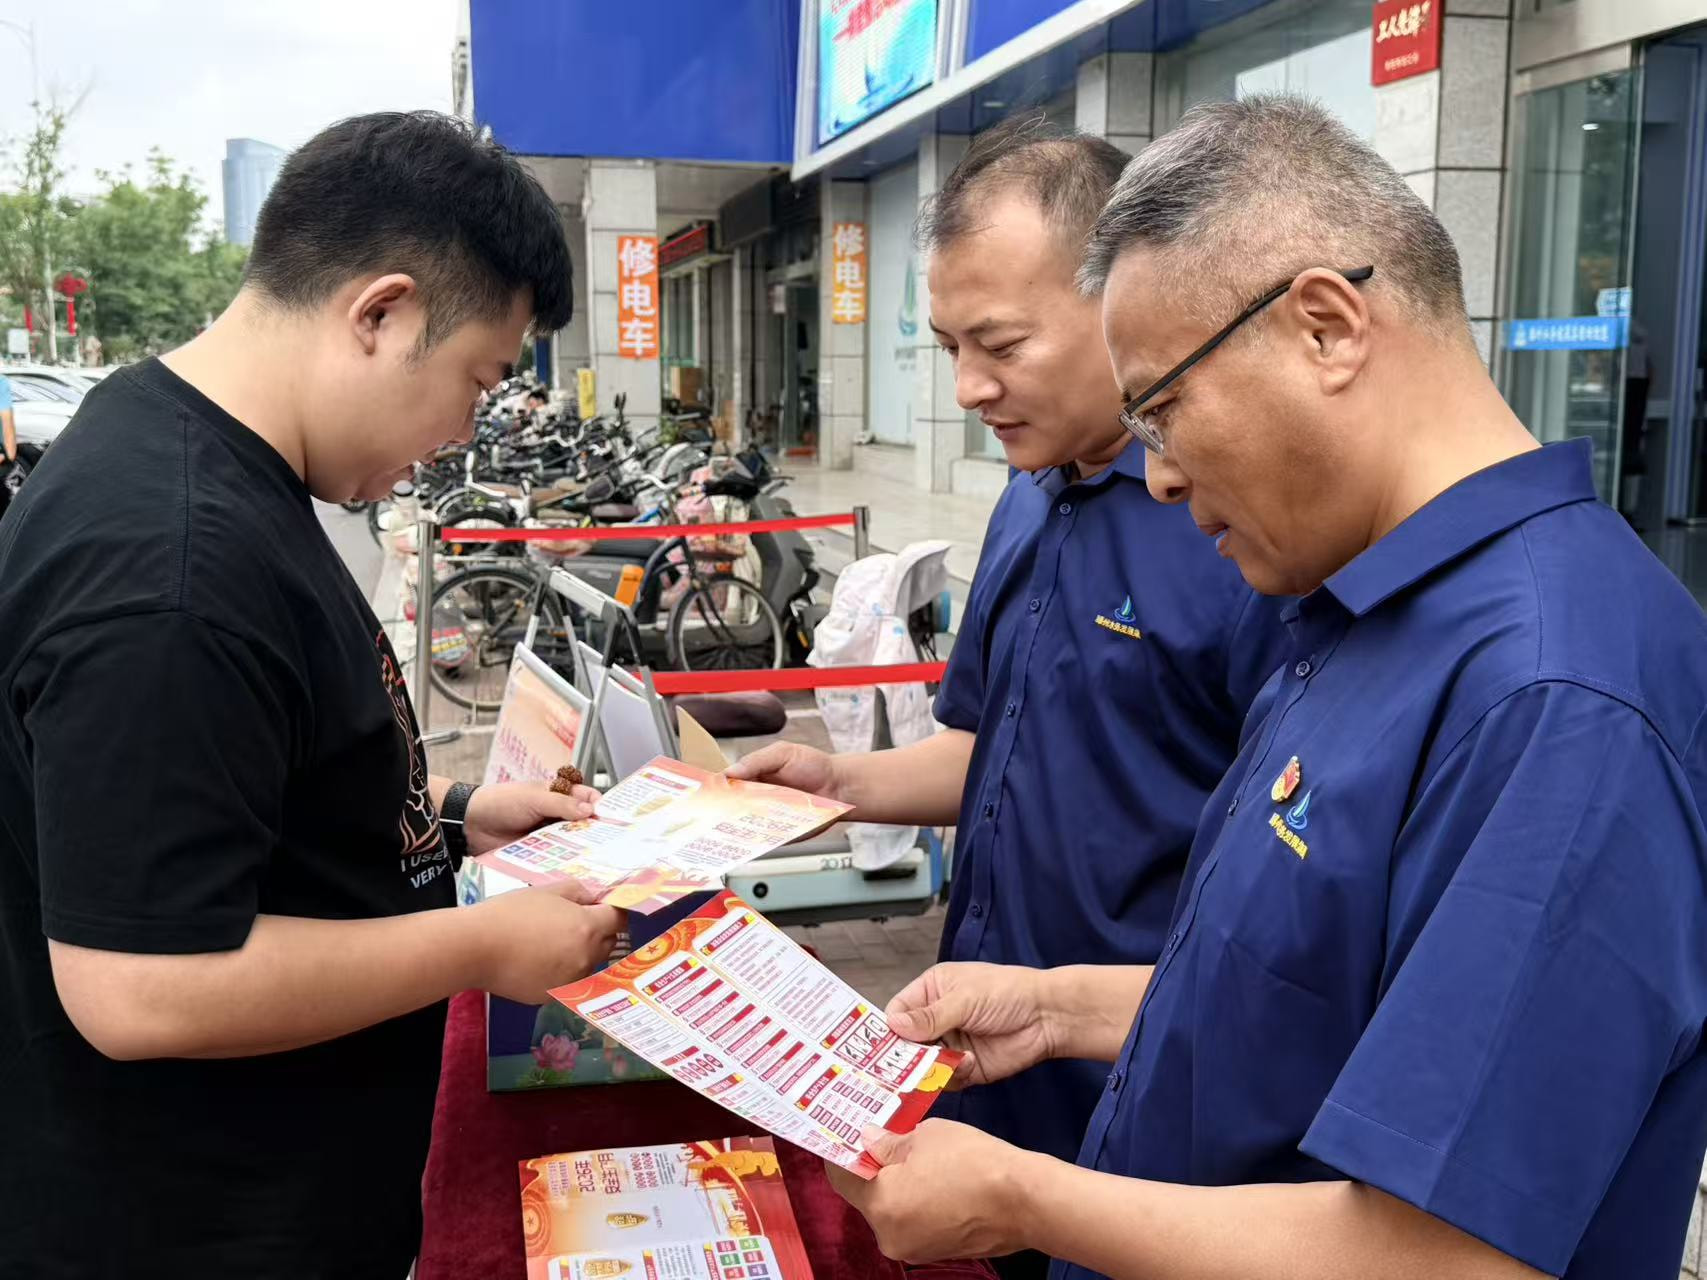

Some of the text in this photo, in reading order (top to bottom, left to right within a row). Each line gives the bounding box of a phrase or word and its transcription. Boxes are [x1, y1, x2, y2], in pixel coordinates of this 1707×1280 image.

[619, 238, 657, 356] 修电车
[834, 225, 866, 321] 修电车
[400, 859, 406, 872] I
[410, 864, 447, 889] VERY
